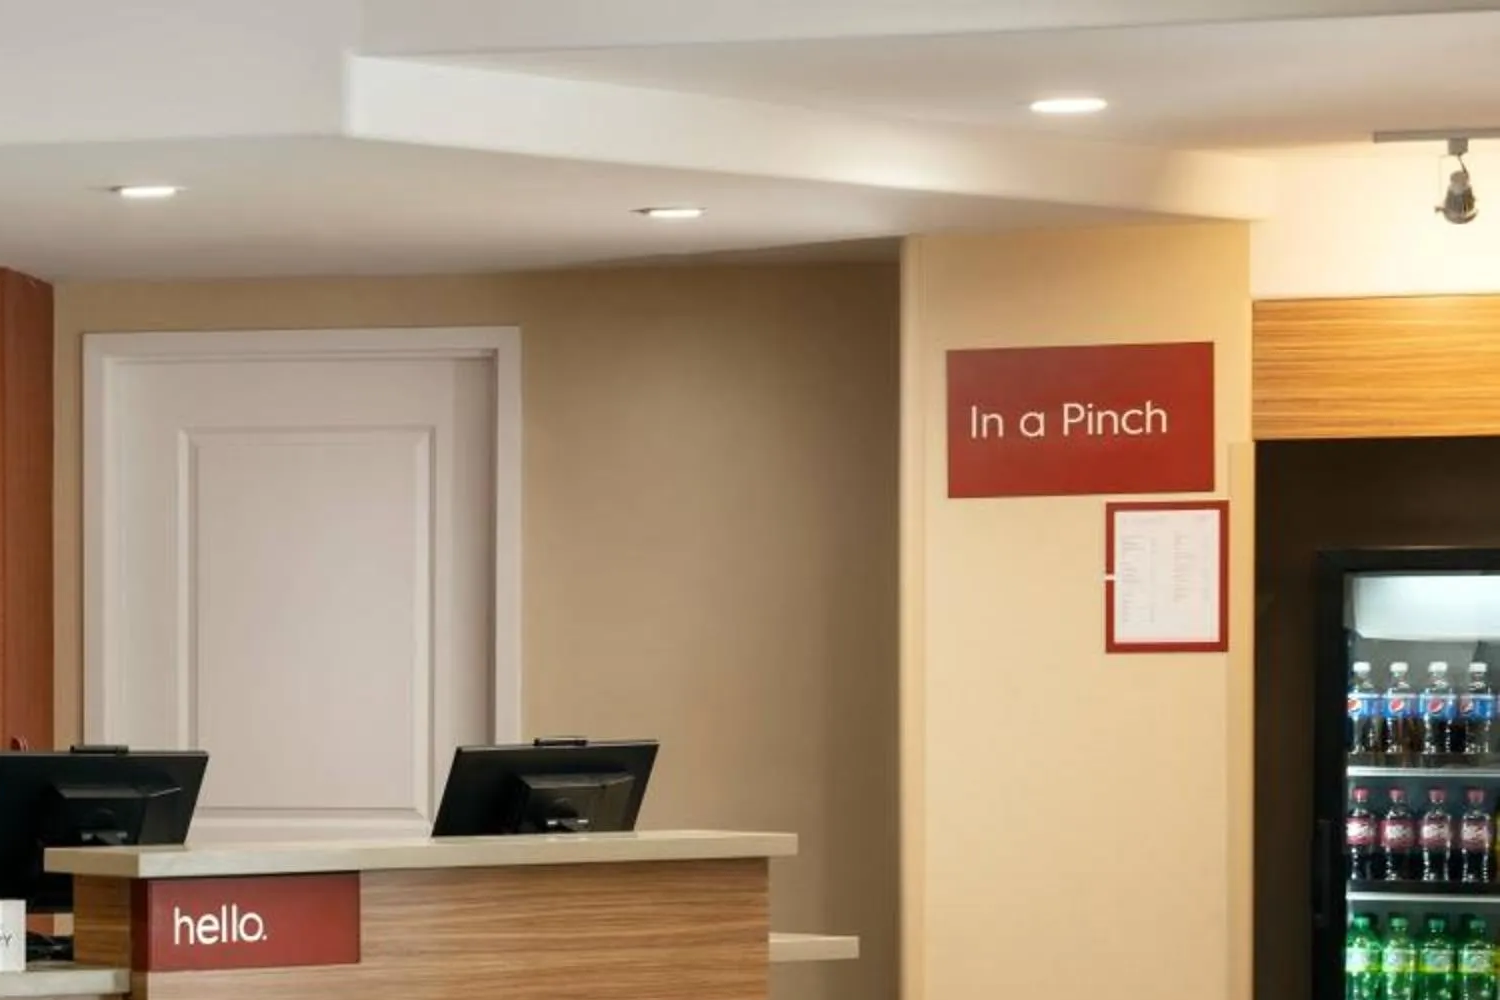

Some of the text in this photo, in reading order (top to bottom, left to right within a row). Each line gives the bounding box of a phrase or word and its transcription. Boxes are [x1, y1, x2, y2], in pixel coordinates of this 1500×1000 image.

[970, 400, 1168, 438] In a Pinch
[174, 903, 268, 945] hello.
